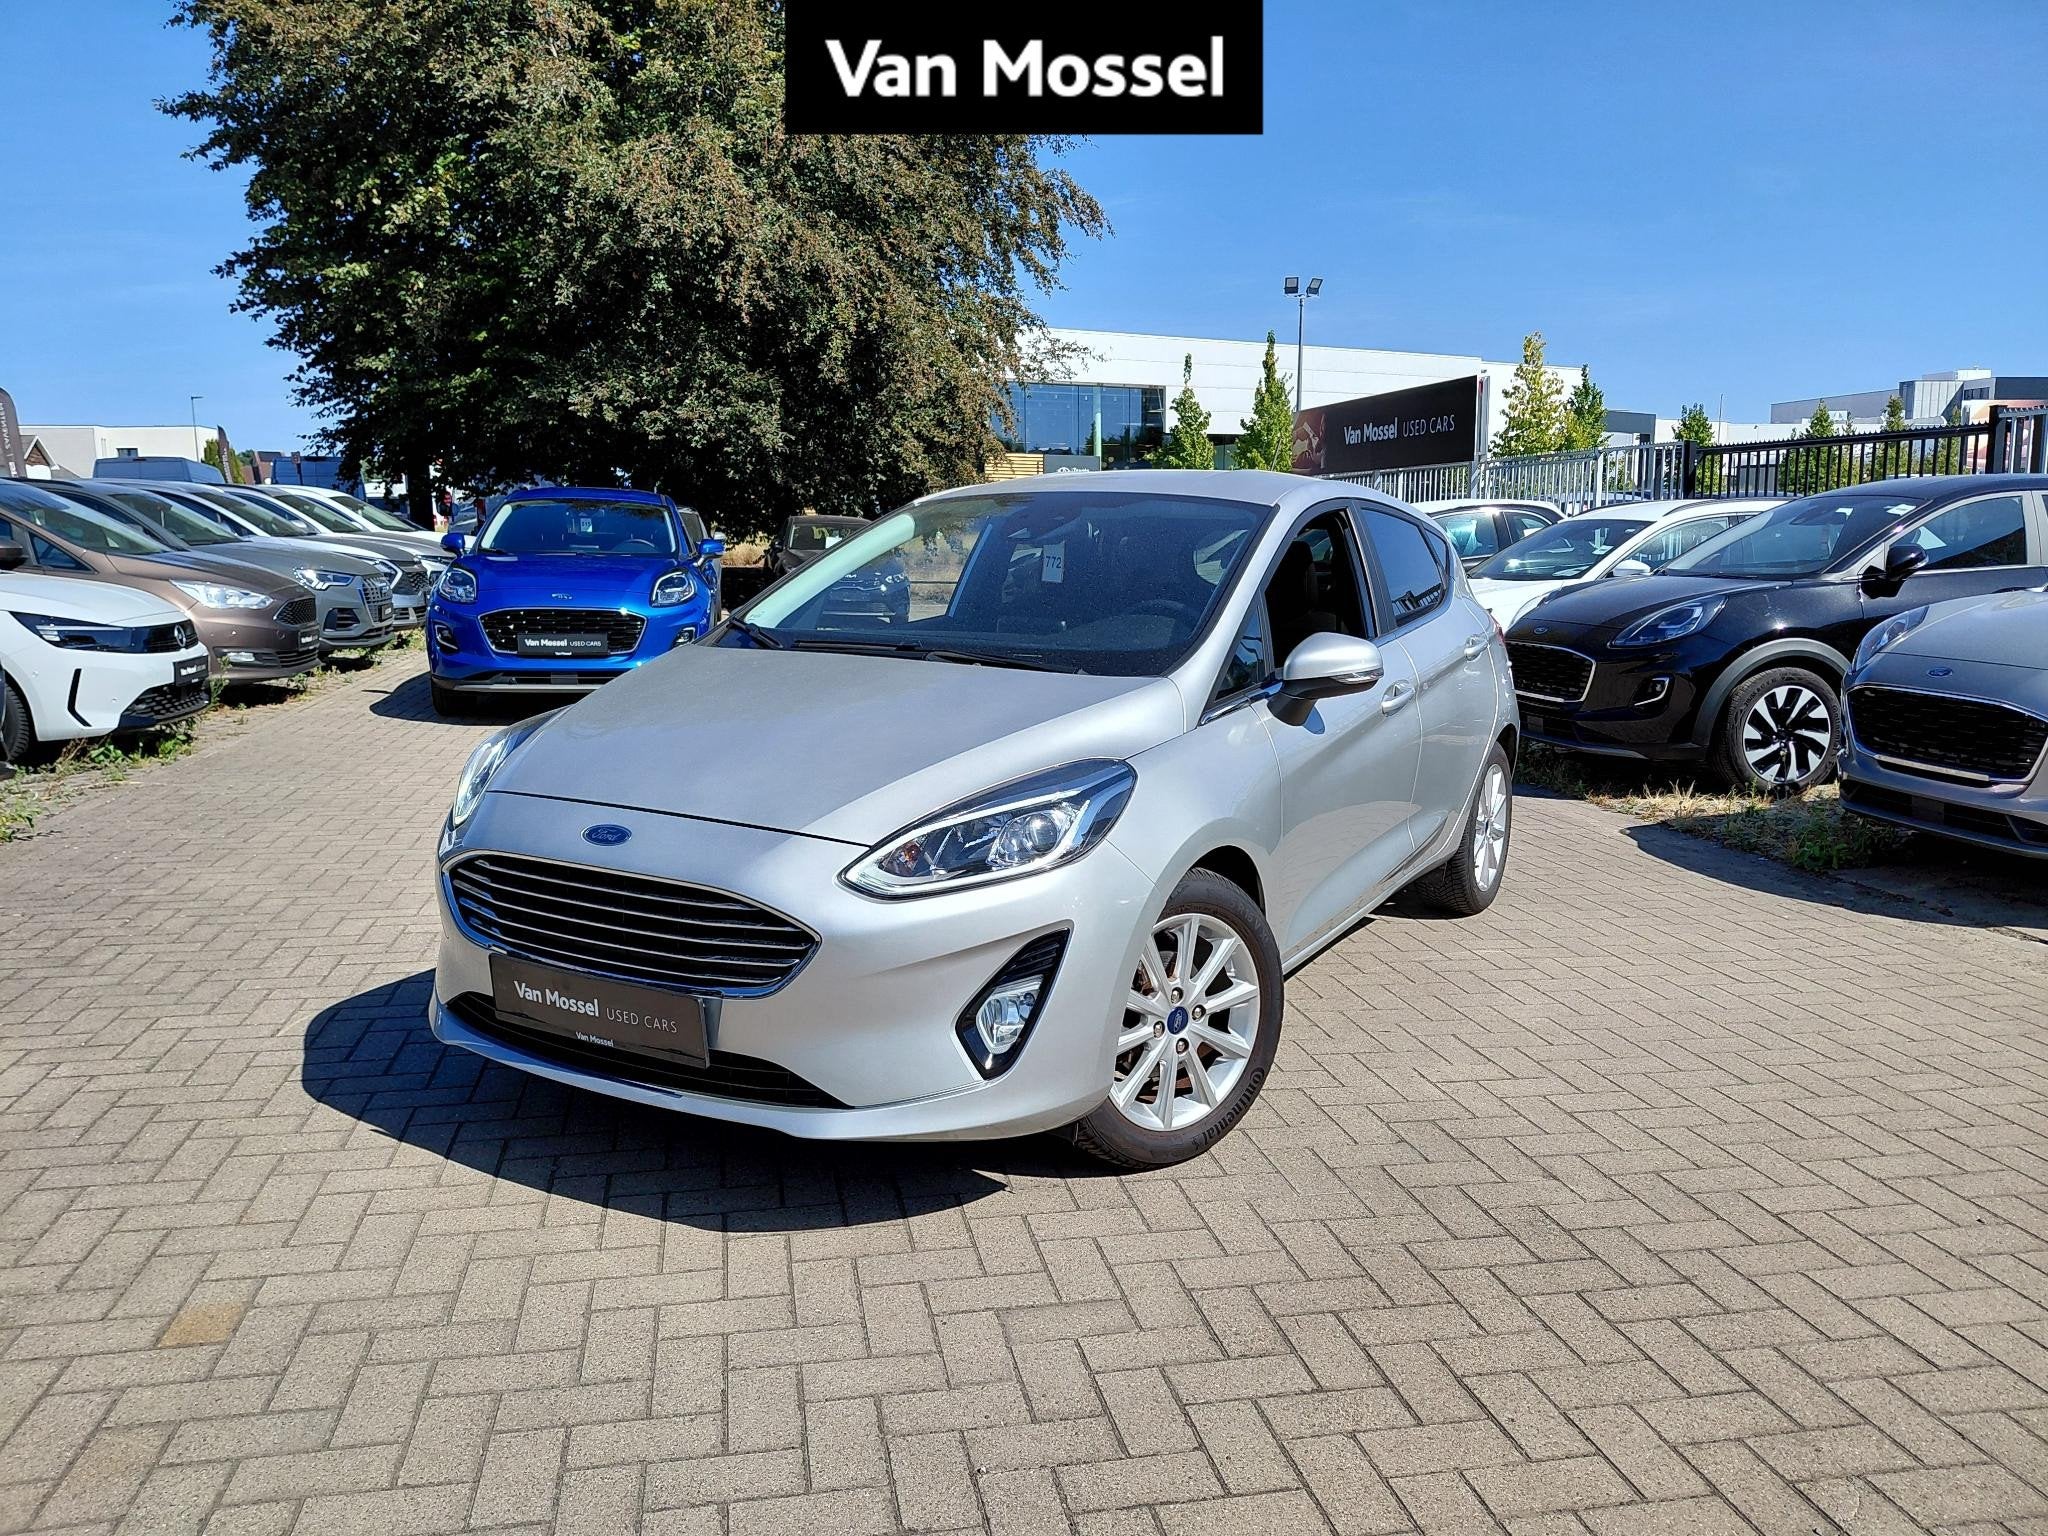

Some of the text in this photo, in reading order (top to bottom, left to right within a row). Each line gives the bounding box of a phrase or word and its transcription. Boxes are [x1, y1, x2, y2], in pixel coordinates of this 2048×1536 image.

[1344, 414, 1455, 445] Van Mossel USED CARS
[1046, 556, 1062, 569] 772
[524, 639, 540, 647] Van
[540, 639, 568, 647] Mossel
[591, 827, 621, 841] Ford
[513, 980, 678, 1033] Van Mossel USED CARS
[575, 1031, 614, 1047] Van Mossel
[1199, 1066, 1265, 1147] Continental
